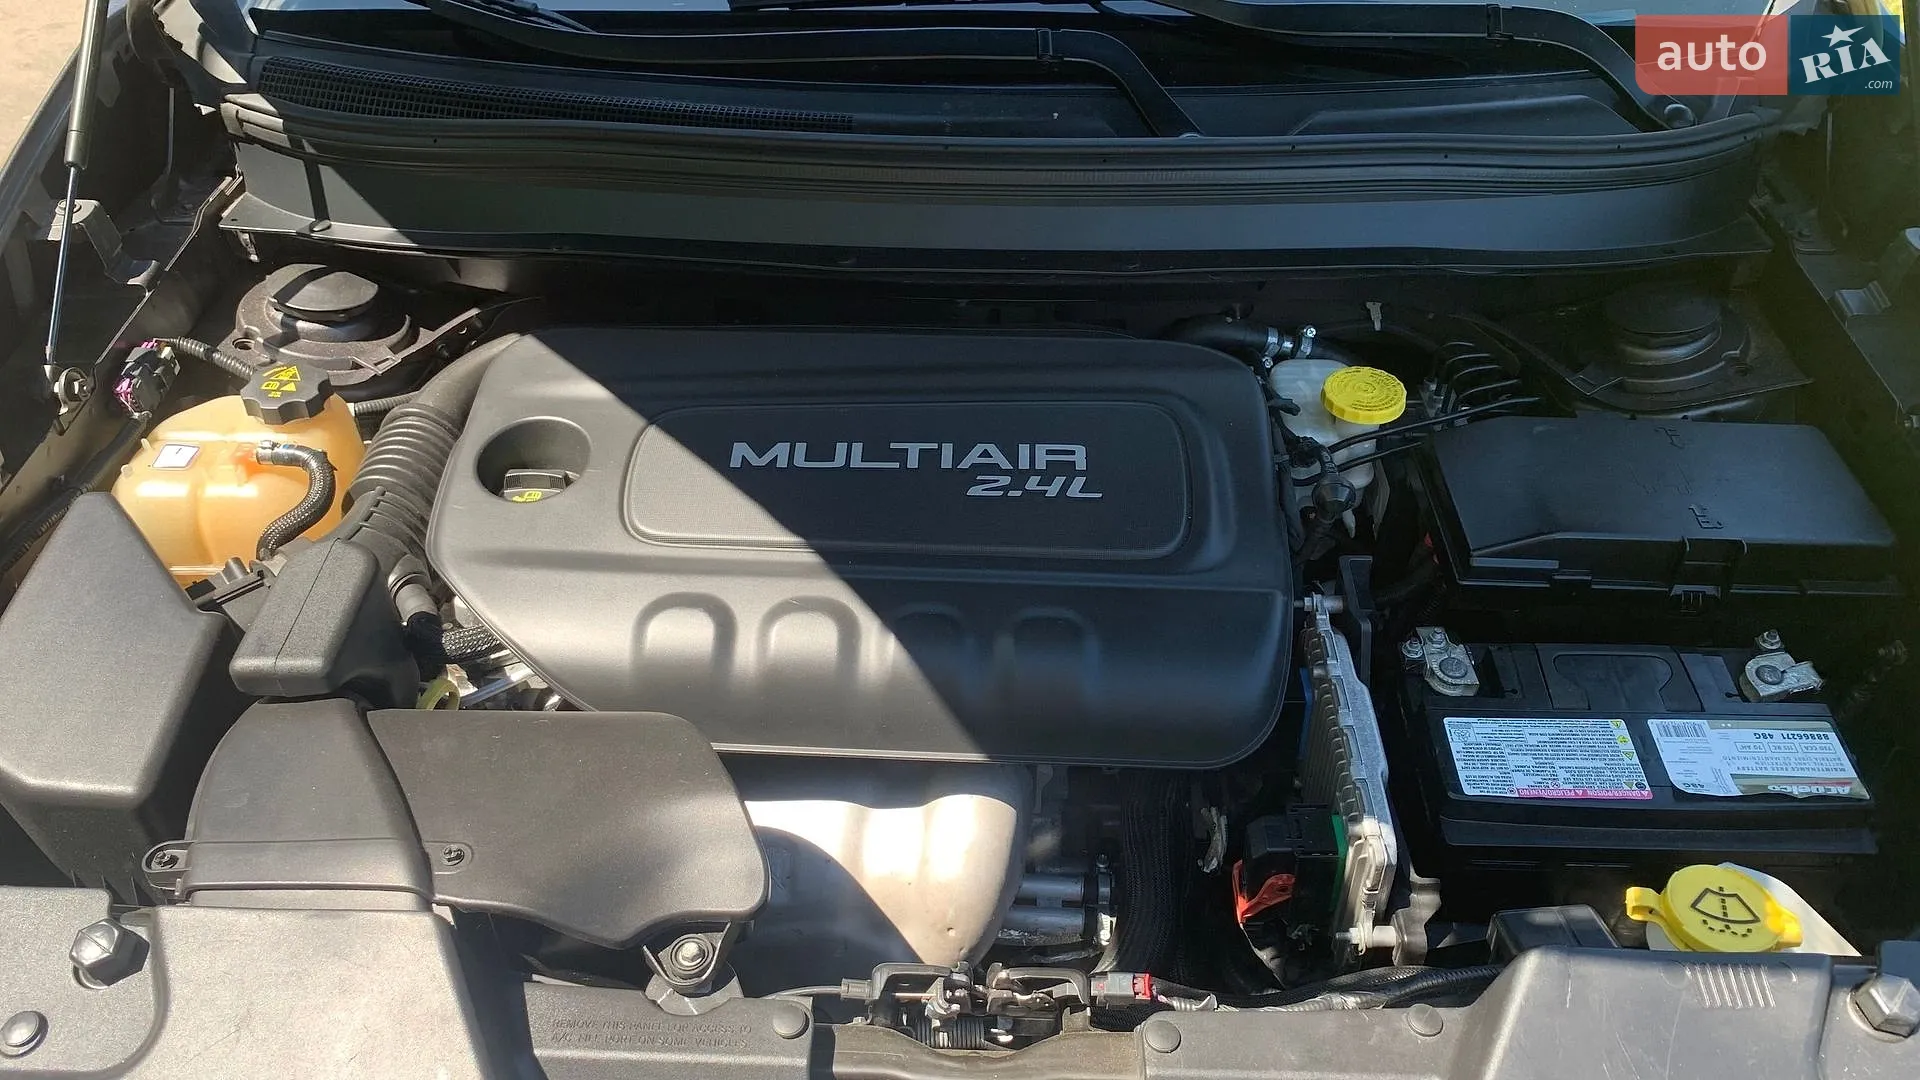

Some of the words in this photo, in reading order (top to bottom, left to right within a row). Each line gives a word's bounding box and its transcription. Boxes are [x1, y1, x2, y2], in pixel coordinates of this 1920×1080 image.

[729, 441, 1087, 471] MULTIAIR
[965, 475, 1103, 499] 2.4L
[1753, 732, 1774, 740] 48G
[1768, 785, 1851, 796] ACDelco
